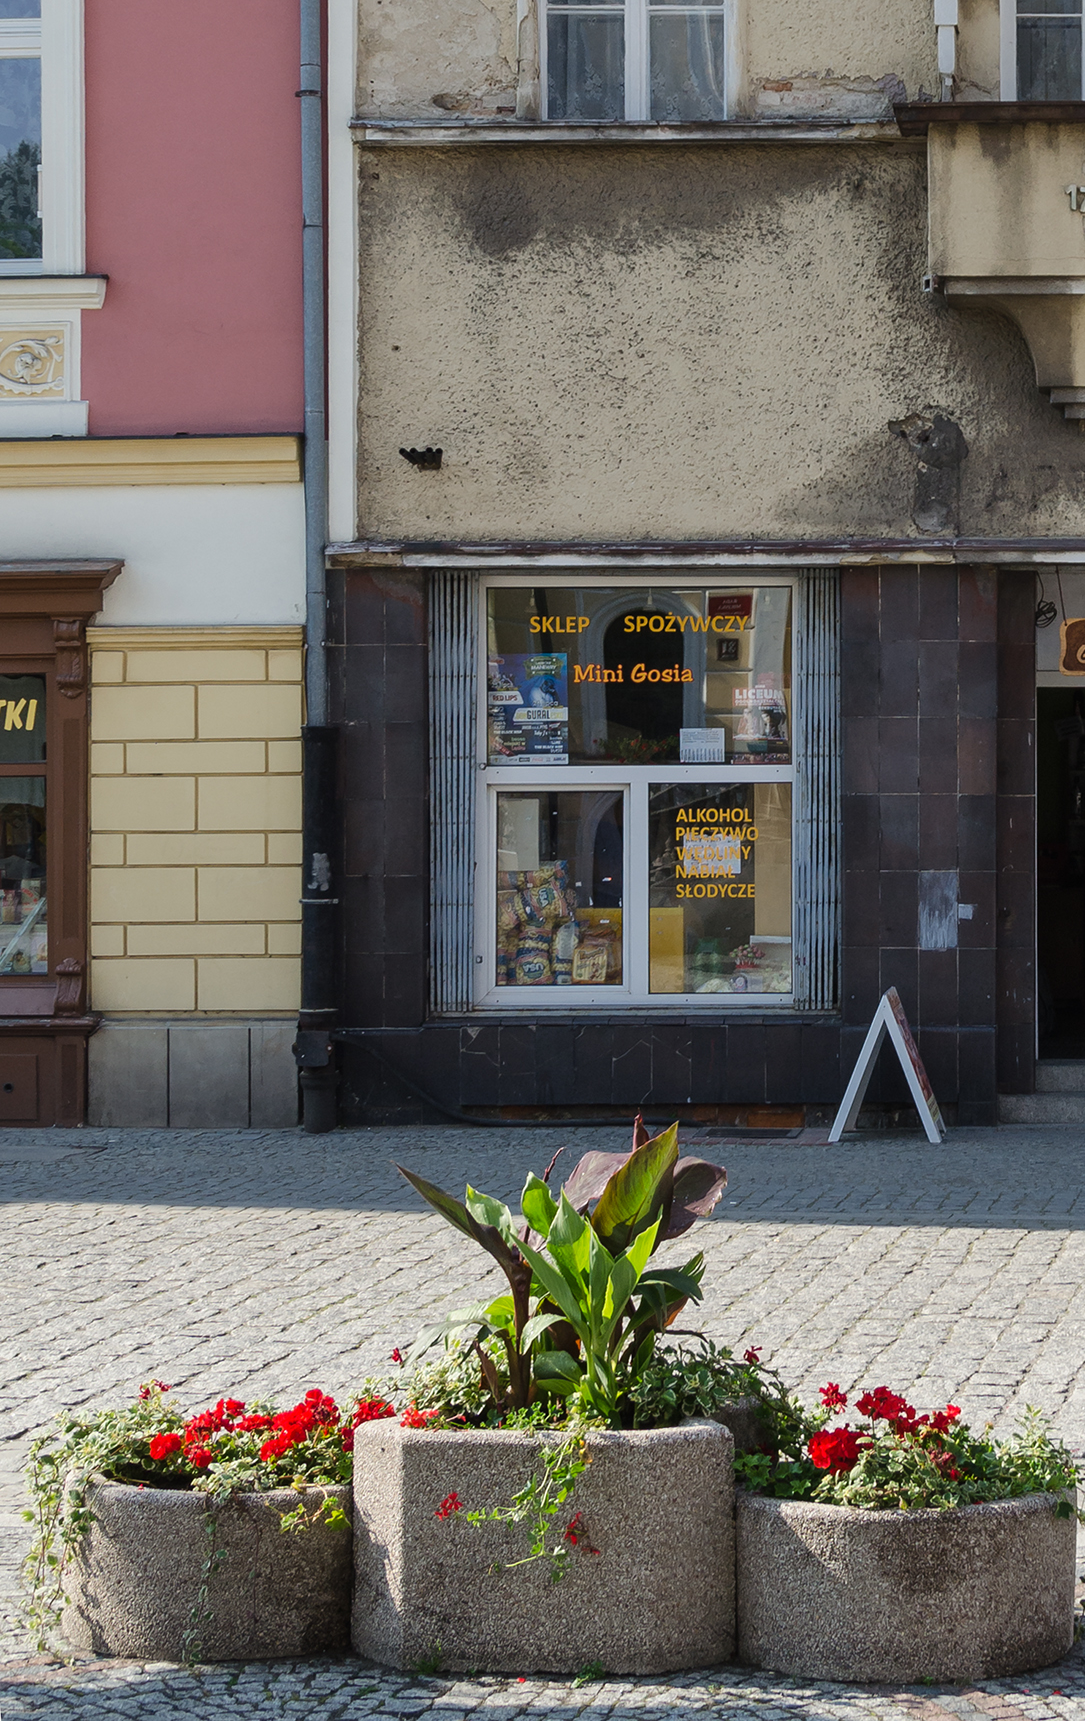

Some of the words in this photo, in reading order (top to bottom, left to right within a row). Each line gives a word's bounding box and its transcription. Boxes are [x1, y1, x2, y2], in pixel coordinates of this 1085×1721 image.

[529, 616, 590, 633] SKLEP
[623, 612, 749, 633] SPOŻYWCZY
[573, 663, 624, 683] Mini
[630, 663, 694, 683] Gosia
[734, 688, 784, 700] LICEUM
[676, 808, 752, 823] ALKOHOL
[675, 826, 760, 841] PIECZYWO
[676, 846, 752, 864] WĘDLINY
[675, 864, 736, 879] NABIAŁ
[675, 883, 756, 898] SŁODYCZE
[522, 961, 546, 973] USA
